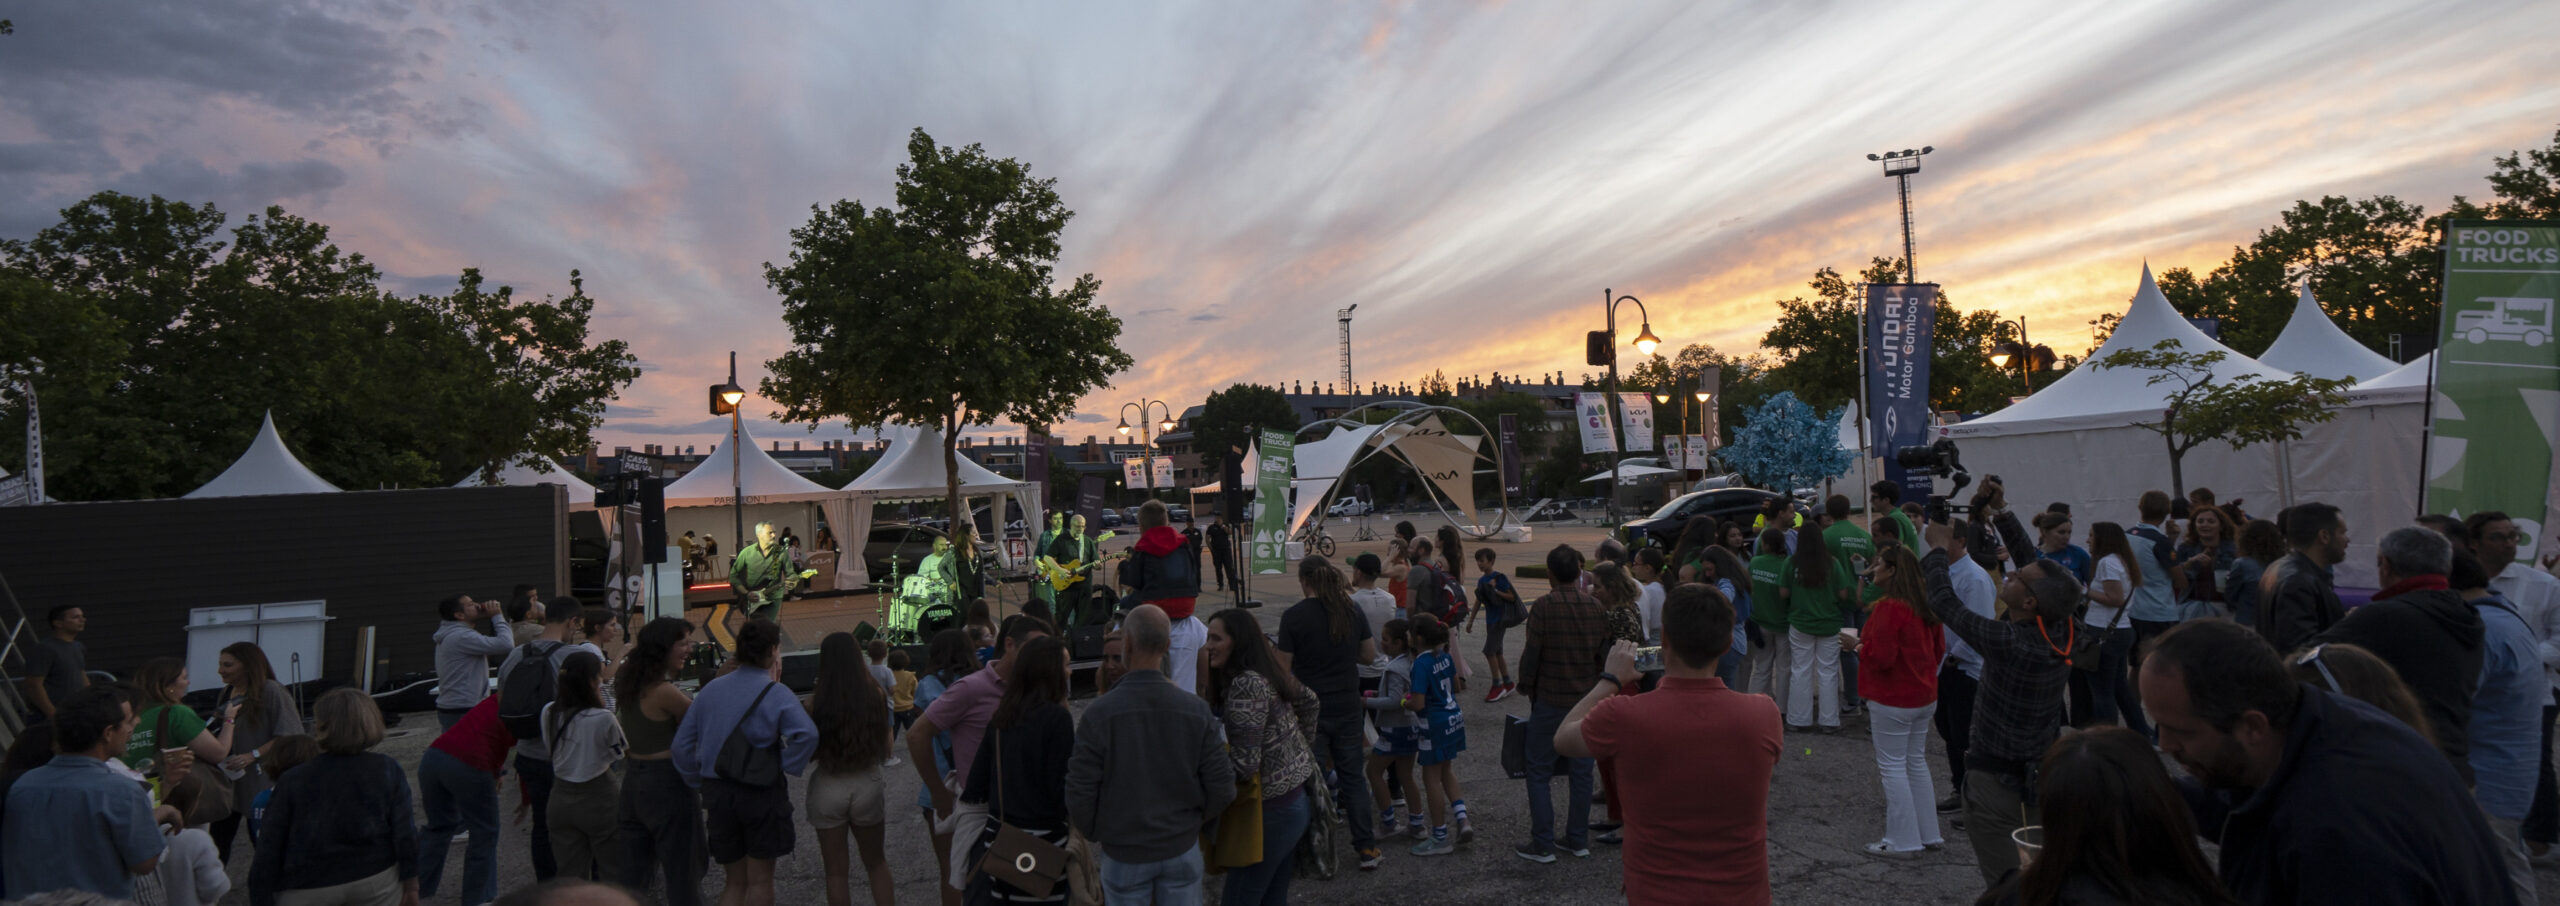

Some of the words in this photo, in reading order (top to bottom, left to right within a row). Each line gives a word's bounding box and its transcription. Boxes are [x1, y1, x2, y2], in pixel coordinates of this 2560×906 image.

[2458, 229, 2530, 245] FOOD
[2456, 247, 2559, 263] TRUCKS
[1903, 297, 1918, 354] Gamboa
[1899, 360, 1913, 398] Motor
[1264, 432, 1285, 440] FOOD
[1264, 438, 1291, 447] TRUCKS
[627, 454, 649, 465] CASA
[624, 462, 653, 473] PASIVA
[927, 609, 953, 618] YAMAHA
